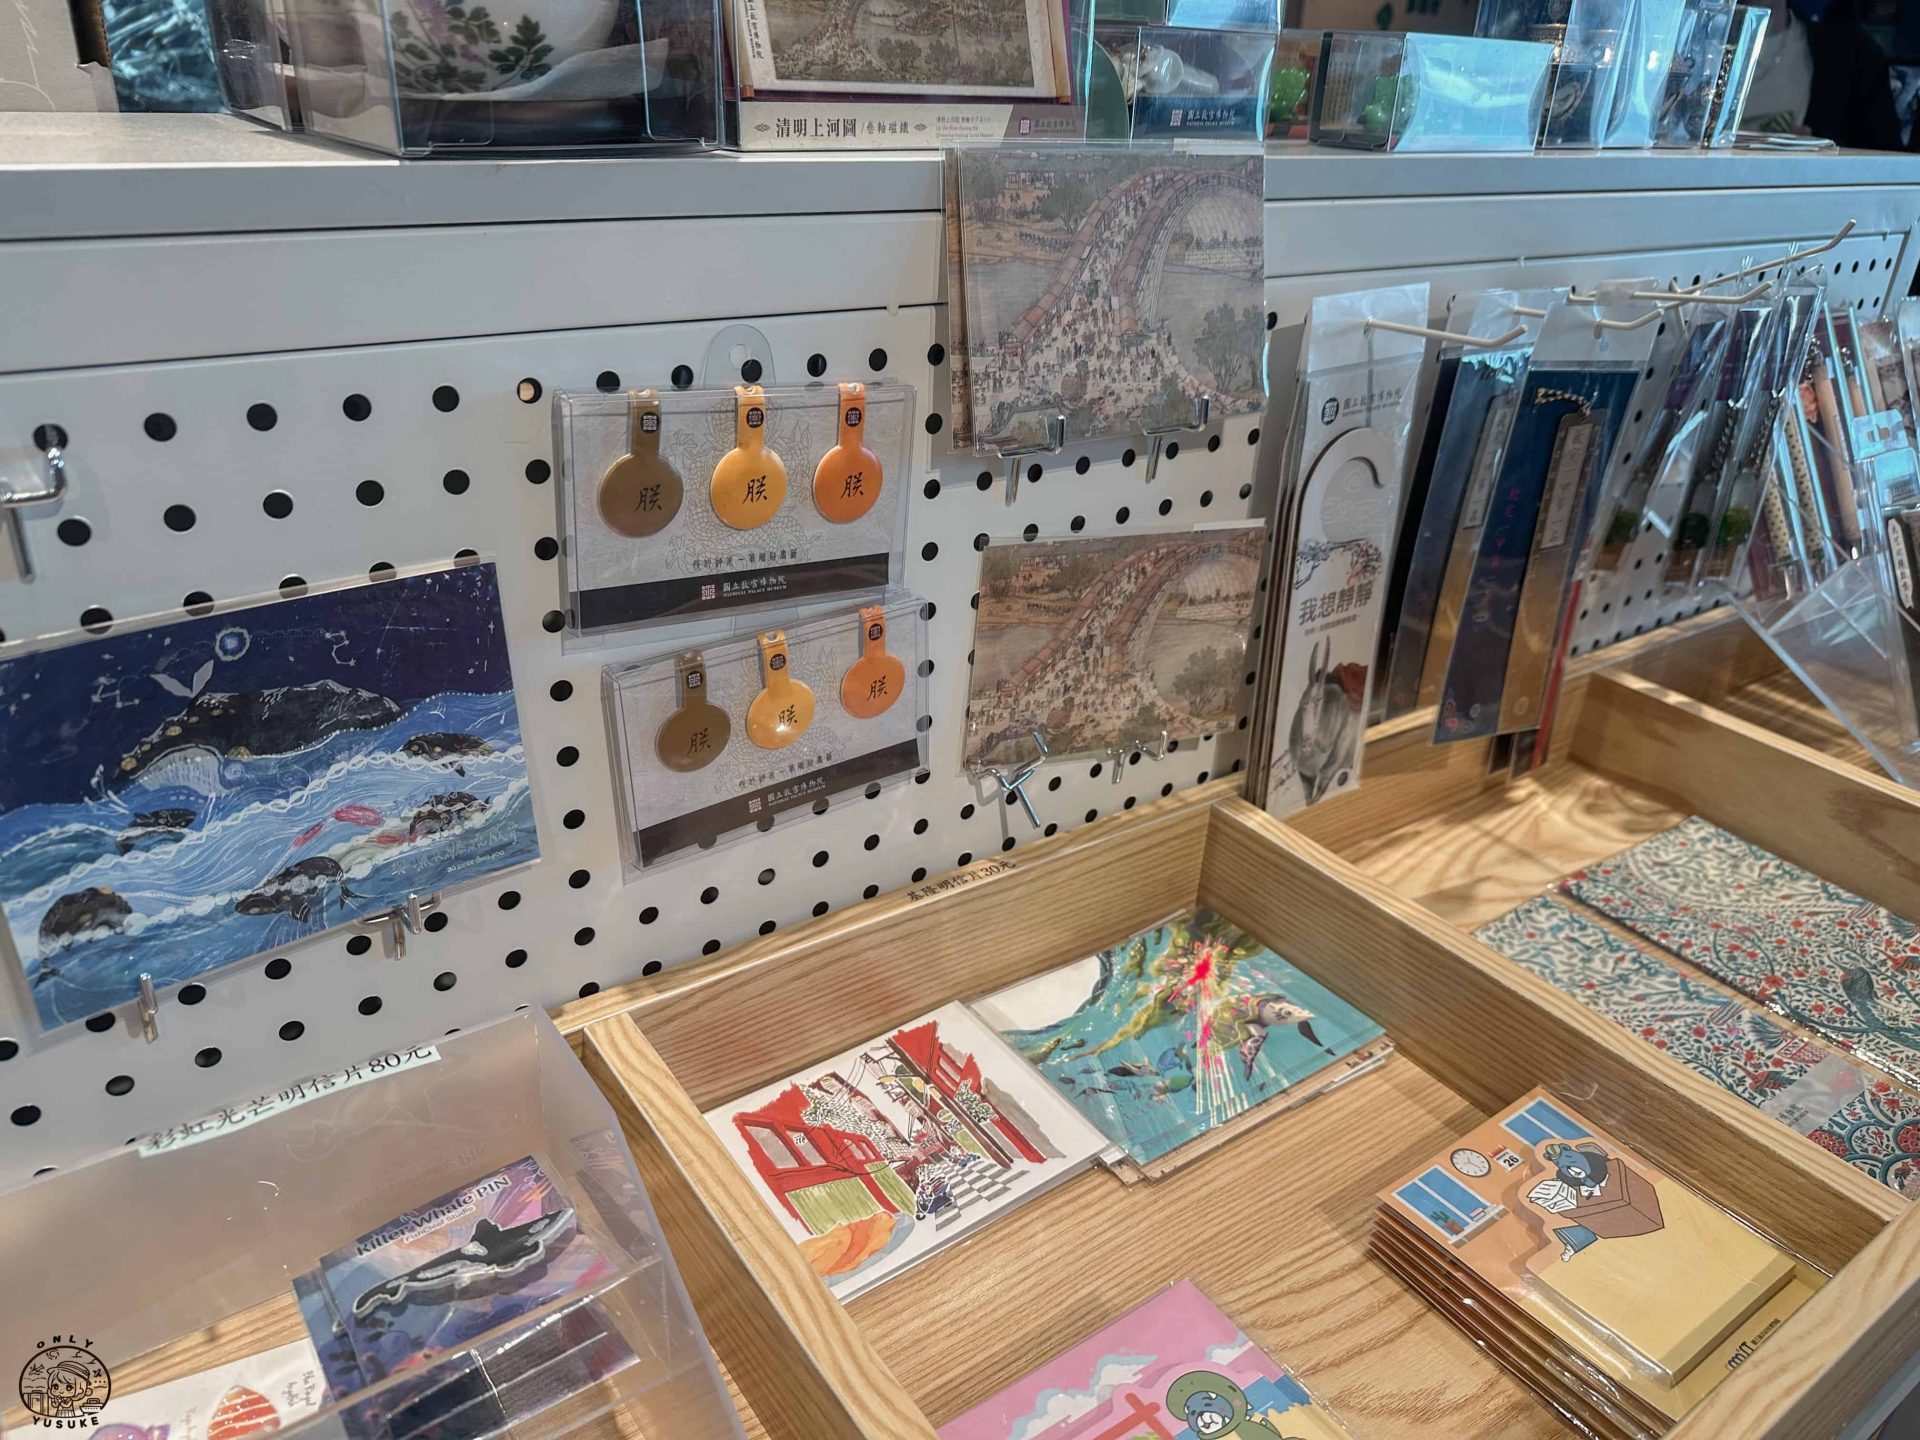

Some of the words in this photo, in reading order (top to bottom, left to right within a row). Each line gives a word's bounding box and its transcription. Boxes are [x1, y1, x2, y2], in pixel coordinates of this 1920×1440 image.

[775, 117, 858, 138] 清明上河圖
[742, 474, 768, 505] 朕
[840, 470, 864, 500] 朕
[634, 486, 663, 513] 朕
[1299, 580, 1373, 626] 我想靜靜
[866, 675, 888, 702] 朕
[777, 703, 799, 726] 朕
[687, 726, 713, 756] 朕
[1503, 1155, 1519, 1168] 26
[356, 1224, 412, 1257] Killer
[412, 1193, 474, 1229] Whale
[476, 1175, 511, 1199] PIN
